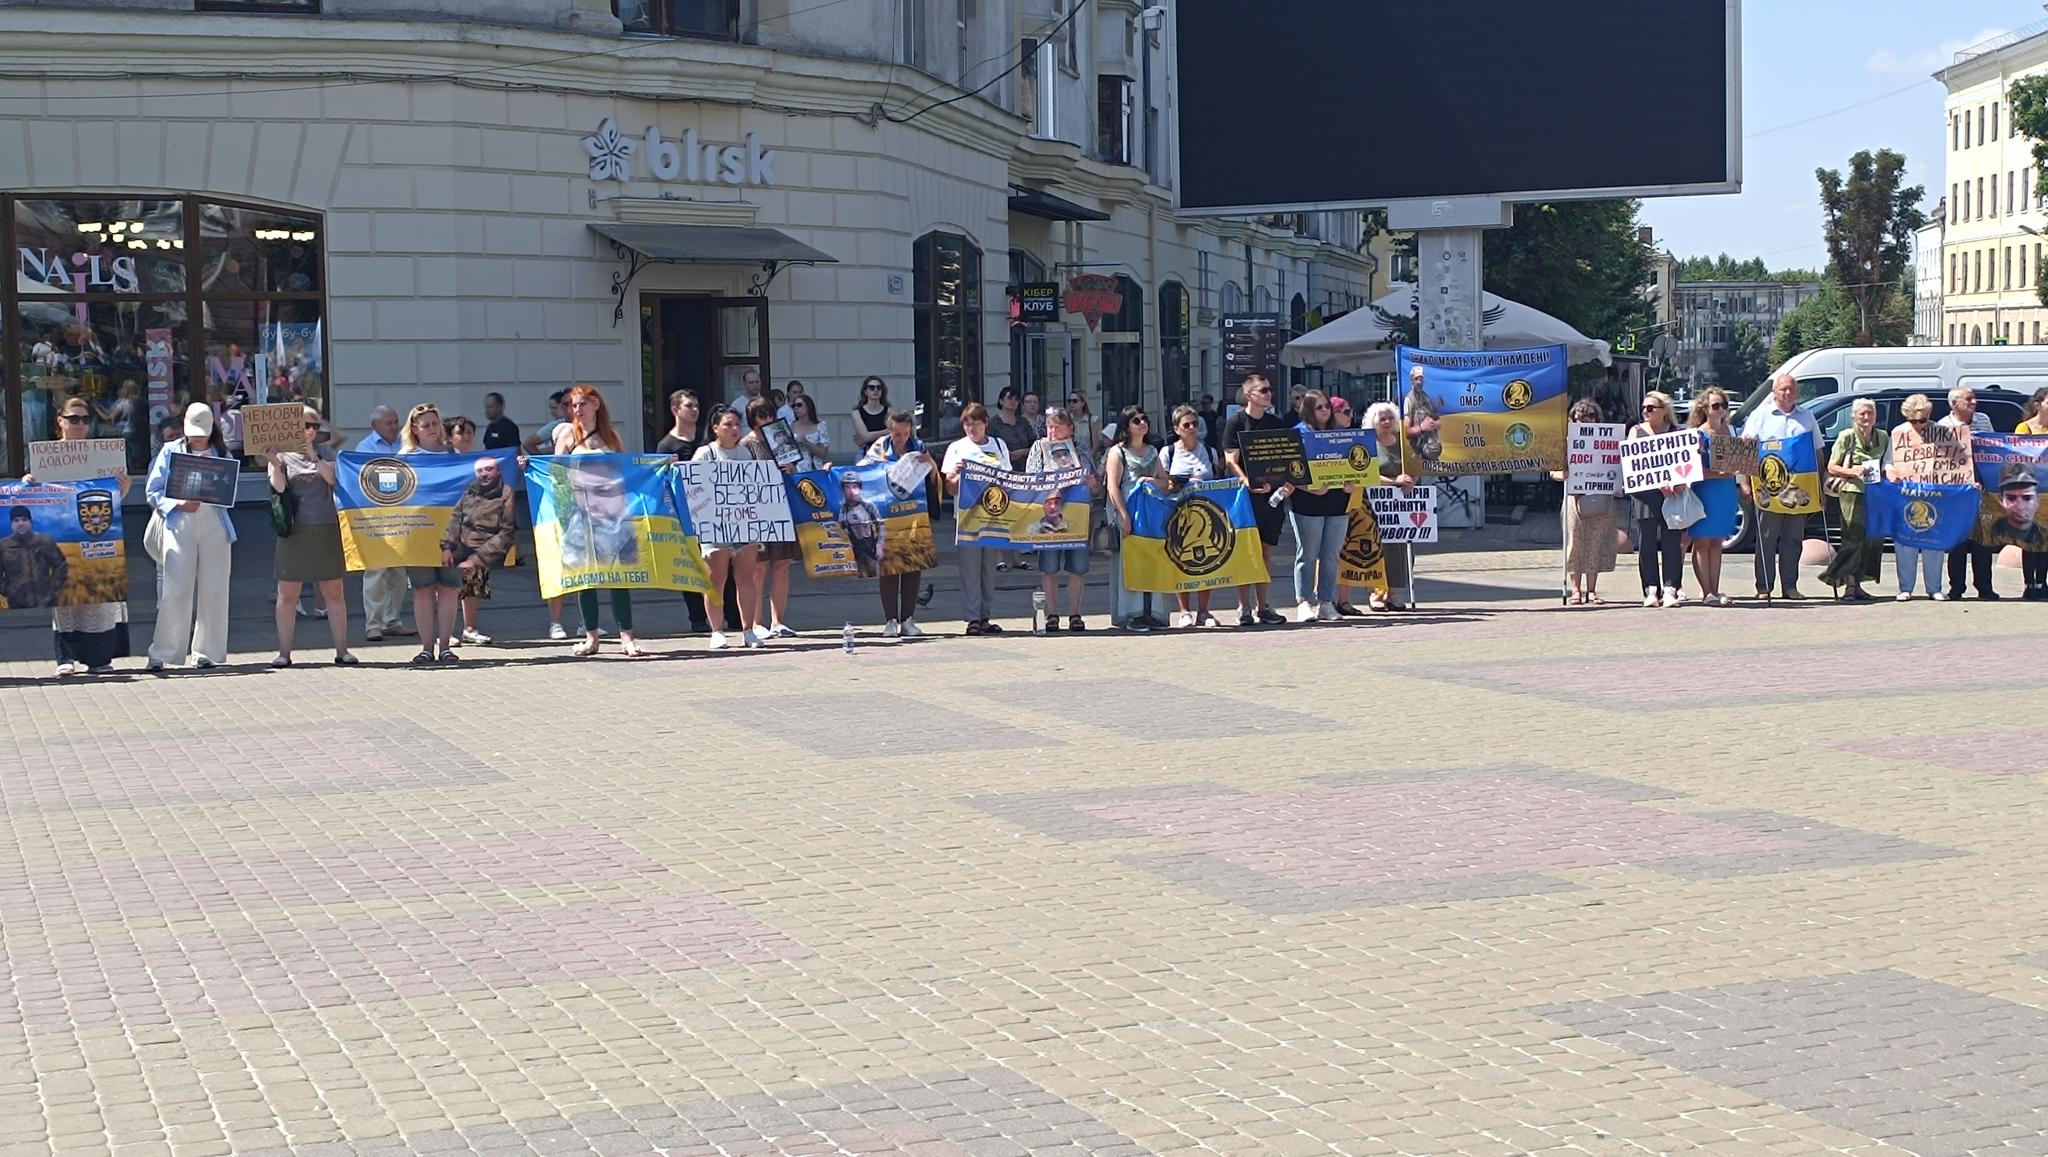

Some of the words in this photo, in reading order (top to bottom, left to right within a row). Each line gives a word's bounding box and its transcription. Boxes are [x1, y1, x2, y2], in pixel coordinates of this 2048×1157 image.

[1024, 288, 1053, 297] КІБЕР
[1024, 302, 1053, 311] КЛУБ
[1440, 356, 1468, 368] МАЮТЬ
[1471, 356, 1496, 367] БУТИ
[1498, 351, 1550, 366] ЗНАЙДЕНІ!
[1466, 383, 1477, 393] 47
[1460, 396, 1484, 407] ОМБР
[243, 409, 259, 423] НЕ
[261, 406, 304, 421] МОВЧИ
[251, 420, 300, 434] ПОЛОН
[1465, 424, 1480, 434] 211
[1580, 427, 1594, 436] МИ
[1598, 427, 1613, 436] ТУТ
[1463, 437, 1486, 447] ОСПБ
[1573, 440, 1585, 449] БО
[1593, 440, 1619, 450] ВОНИ
[1621, 433, 1697, 457] ПОВЕРНІТЬ
[1895, 431, 1913, 451] ДЕ
[1921, 426, 1962, 443] ЗНИКЛІ
[32, 441, 90, 455] ПОВЕРНІТЬ
[93, 439, 126, 453] ГЕРОЇВ
[39, 454, 88, 469] ДОДОМУ
[1422, 460, 1465, 472] ПОВЕРНІТЬ
[1466, 460, 1497, 472] ГЕРОЇВ
[1500, 458, 1545, 471] ДОДОМУ!
[1569, 454, 1593, 465] ДОСІ
[1601, 454, 1621, 464] ТАМ
[1631, 449, 1690, 472] НАШОГО
[709, 461, 771, 484] ЗНИКЛІ
[1913, 461, 1926, 472] 47
[1626, 470, 1672, 489] БРАТА
[1919, 471, 1939, 484] МІЙ
[1370, 488, 1393, 499] МОЯ
[1375, 499, 1427, 512] ОБІЙНЯТИ
[1376, 514, 1400, 525] ИНА
[713, 521, 741, 543] МІЙ
[748, 520, 790, 542] БРАТ
[1380, 527, 1418, 540] ИВОГО
[607, 571, 622, 584] НА
[624, 570, 649, 583] ТЕБЕ!
